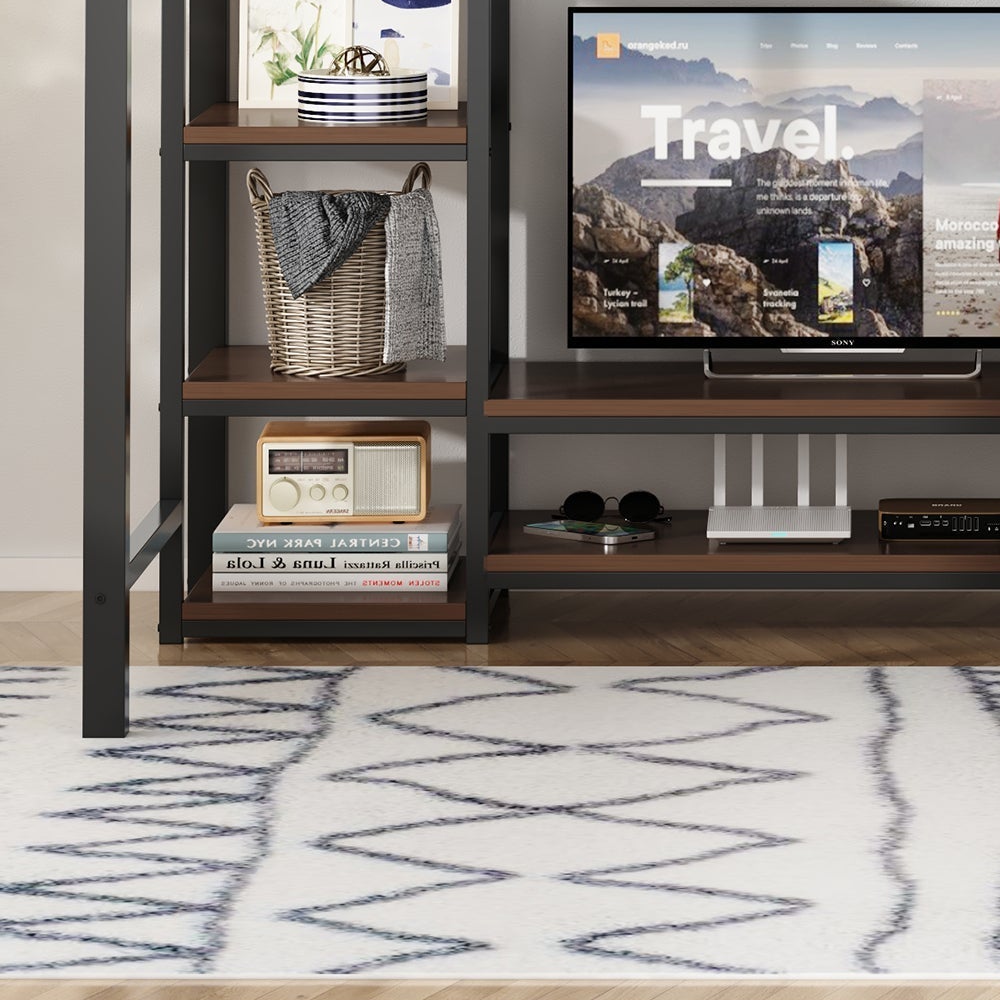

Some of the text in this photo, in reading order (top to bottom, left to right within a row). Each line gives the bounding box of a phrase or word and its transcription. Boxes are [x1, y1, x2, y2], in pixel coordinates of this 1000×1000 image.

[641, 105, 855, 161] Travel.
[809, 193, 847, 202] departure
[756, 207, 790, 215] unknown
[936, 219, 999, 231] Morocco
[936, 237, 995, 252] amazing
[603, 288, 631, 299] Turkey
[763, 288, 799, 297] Svanetia
[603, 299, 648, 310] Lycian trail
[763, 299, 797, 310] tracking
